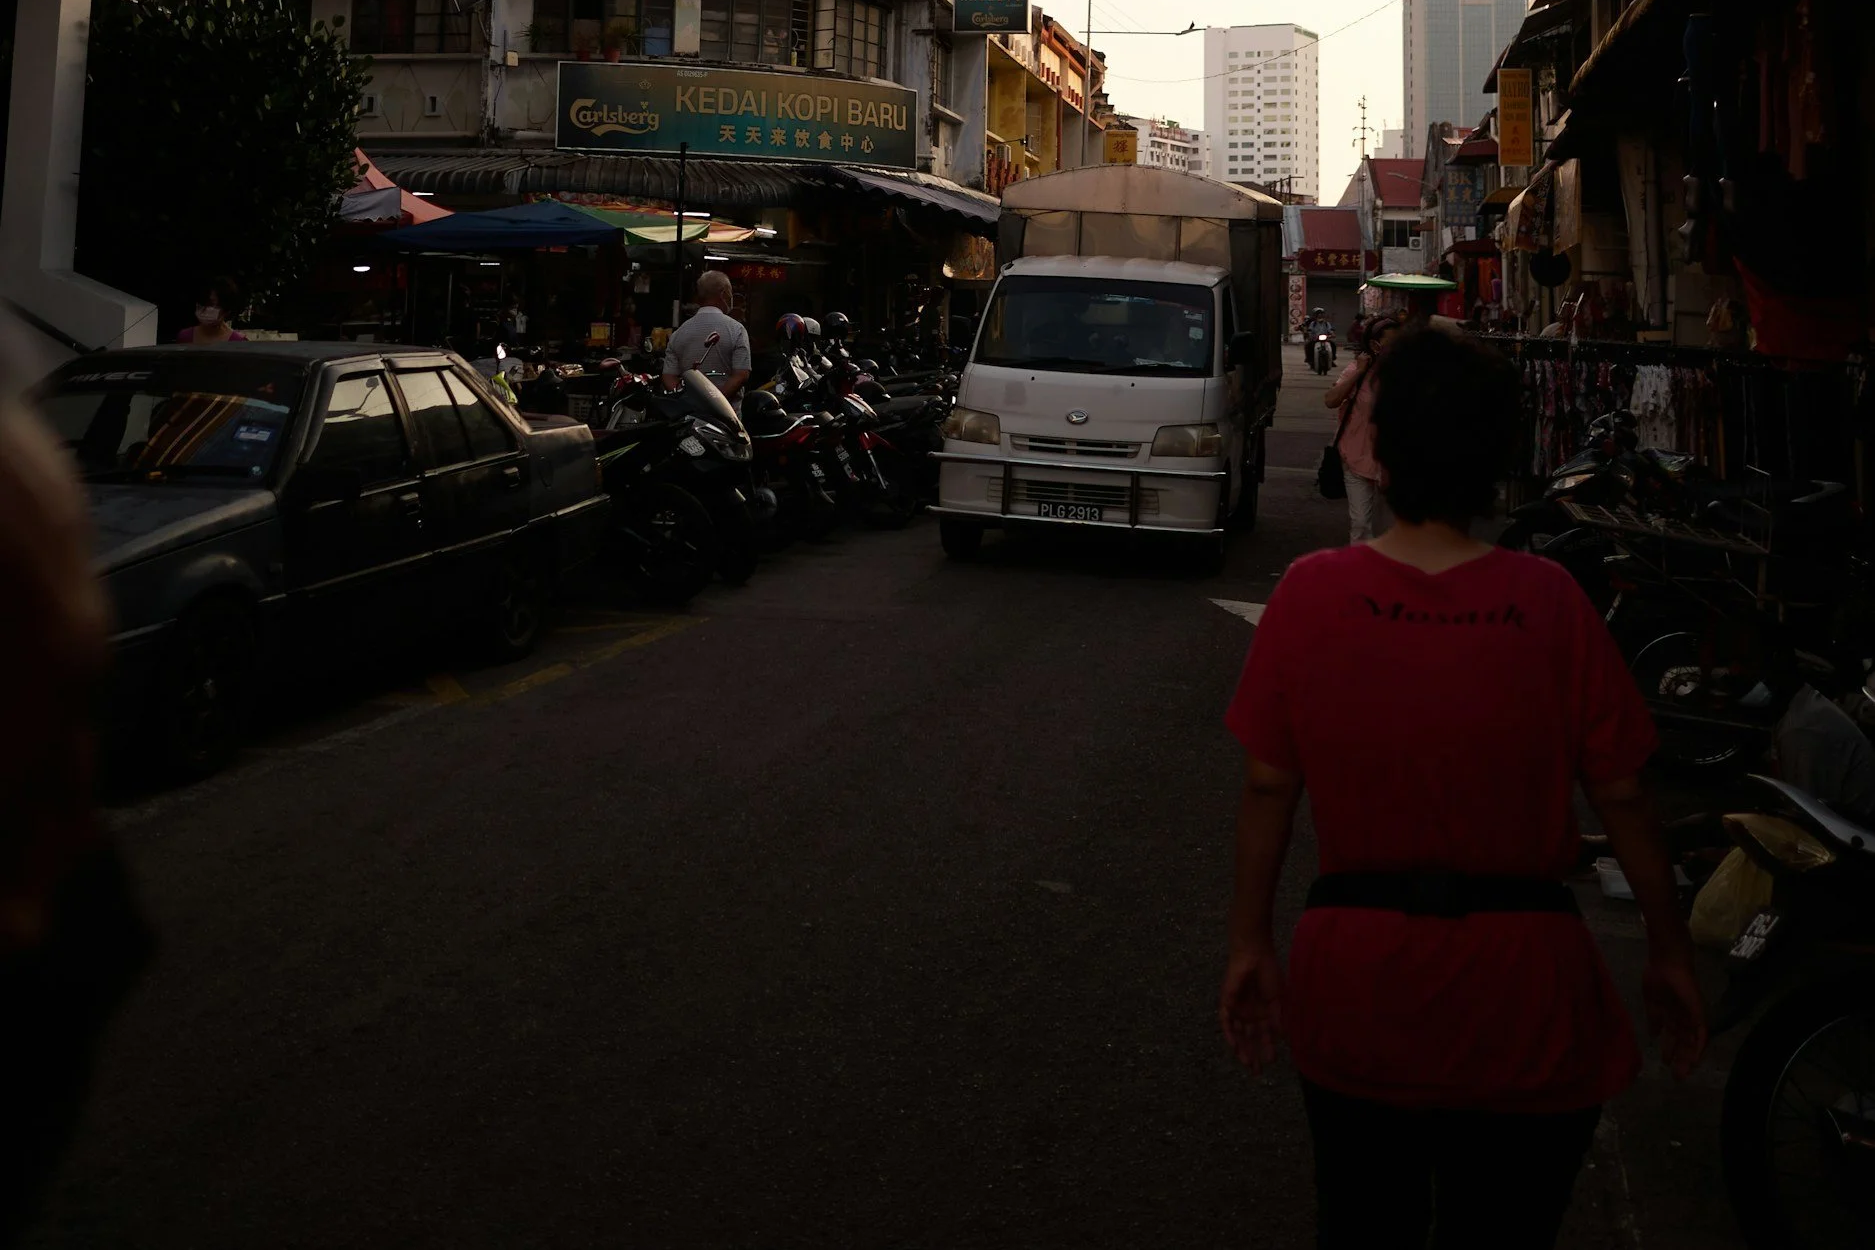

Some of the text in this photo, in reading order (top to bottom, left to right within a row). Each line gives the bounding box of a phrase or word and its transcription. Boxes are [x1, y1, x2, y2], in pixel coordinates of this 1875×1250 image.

[971, 11, 1009, 28] Carlsberg
[569, 99, 660, 137] Carlsberg
[675, 85, 907, 131] KEDAI KOPI BARU
[718, 124, 876, 154] 天天来饮食中心
[1041, 503, 1100, 520] PLG 2913
